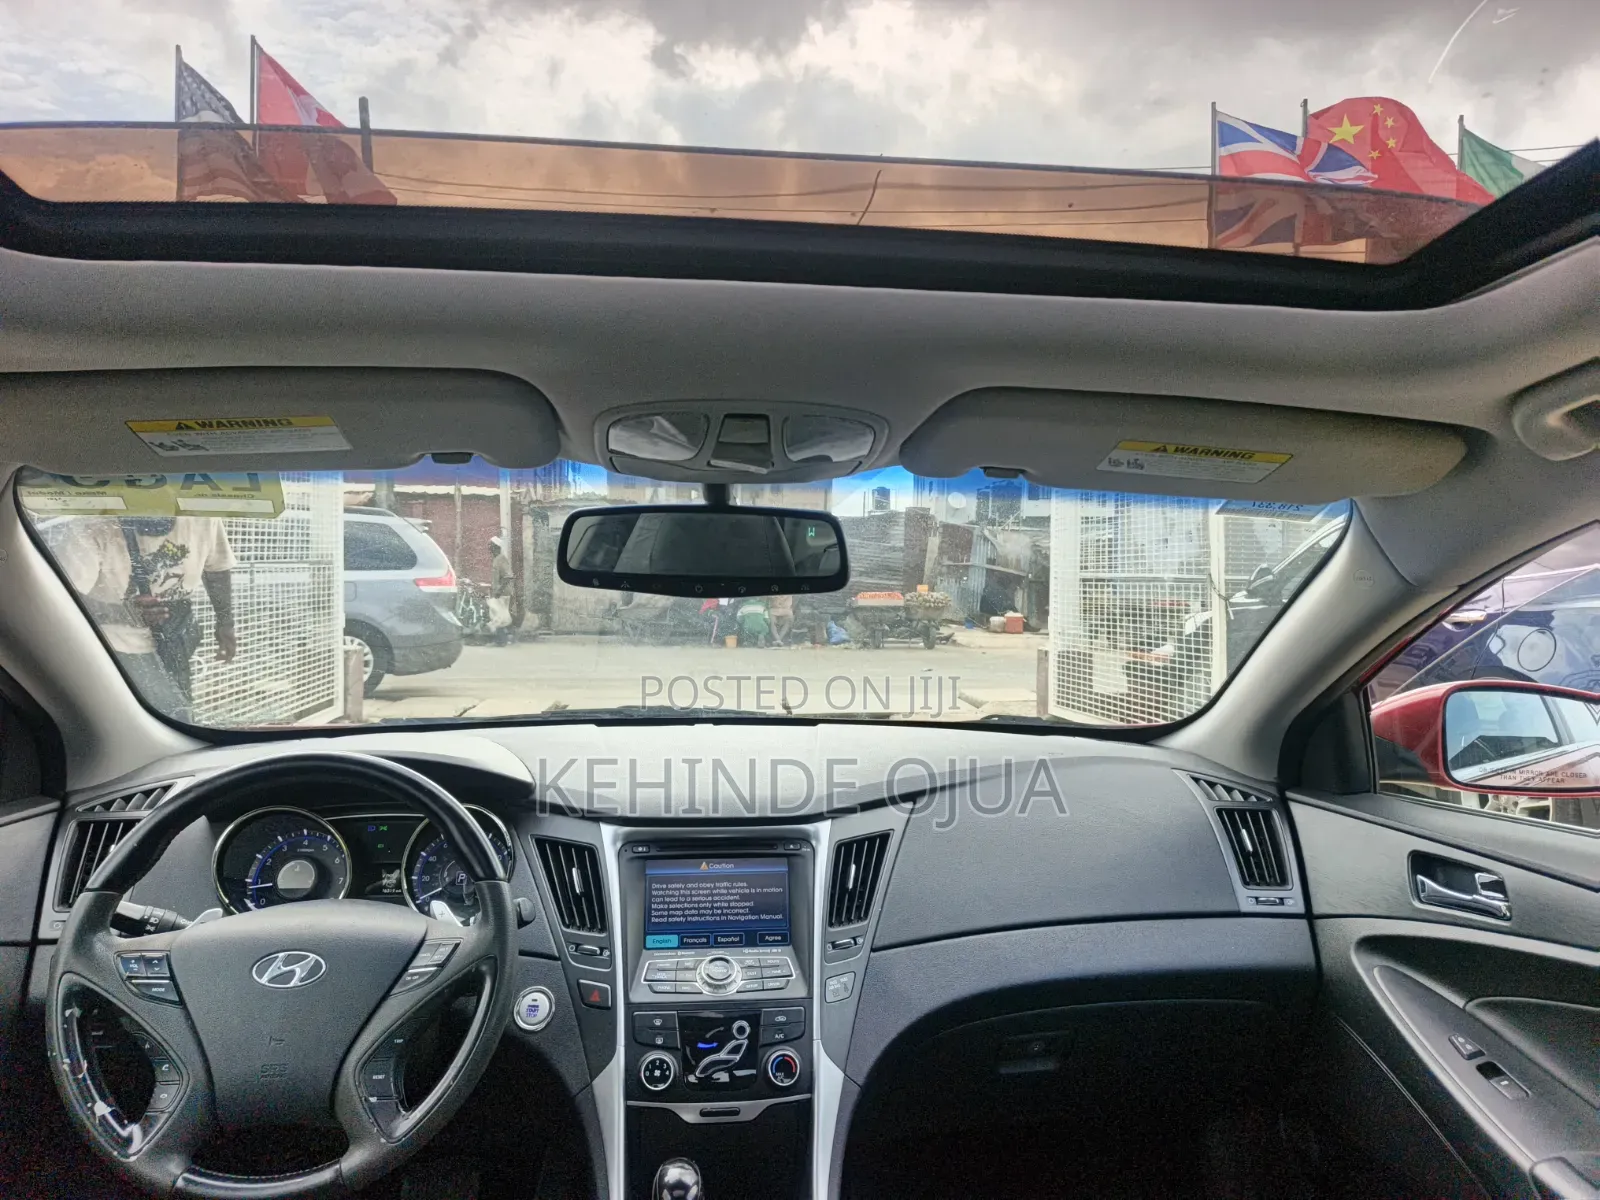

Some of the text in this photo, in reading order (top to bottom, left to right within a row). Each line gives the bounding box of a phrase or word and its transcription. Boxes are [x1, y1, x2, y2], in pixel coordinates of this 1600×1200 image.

[194, 417, 294, 430] WARNING
[1173, 446, 1256, 460] WARNING
[1561, 771, 1587, 779] CLOSER
[708, 862, 735, 870] Caution
[458, 873, 466, 883] P
[667, 882, 686, 890] safely
[698, 881, 715, 889] obey
[651, 889, 680, 897] Watching
[727, 914, 760, 922] Navigation
[652, 937, 672, 945] English
[683, 937, 708, 945] Français
[764, 934, 782, 942] Agree
